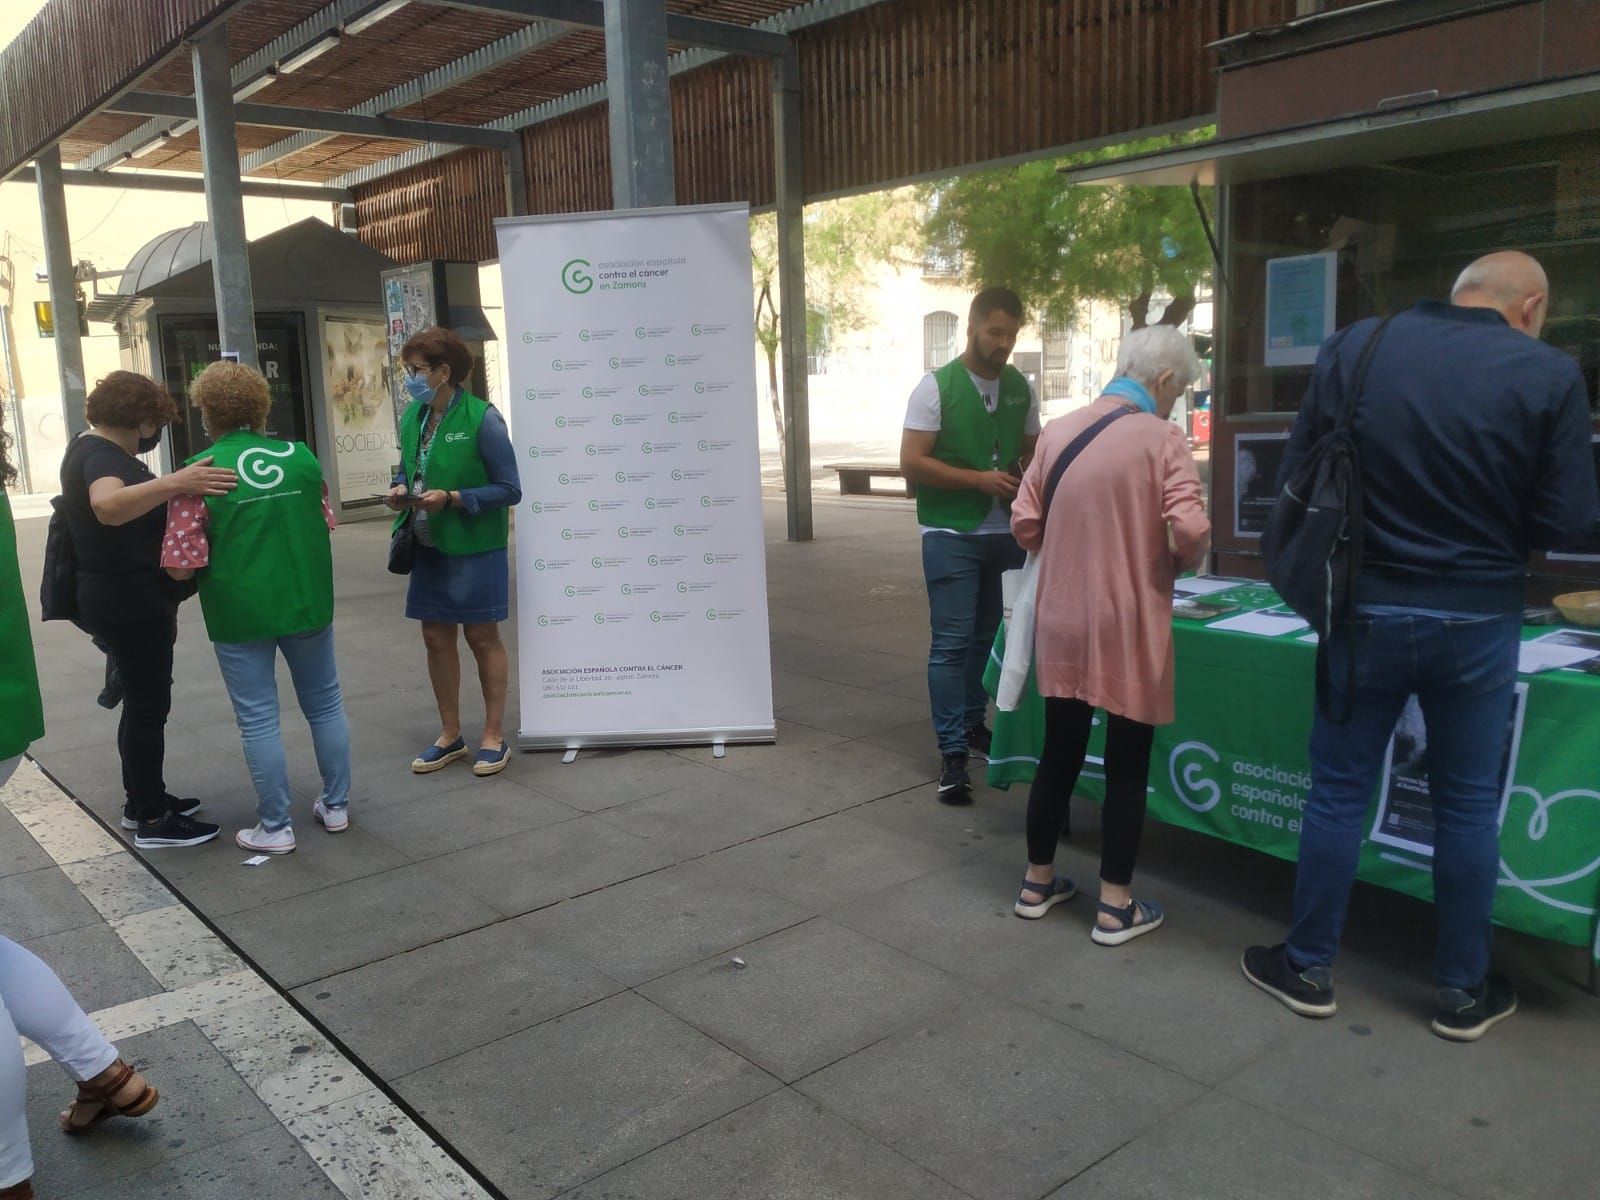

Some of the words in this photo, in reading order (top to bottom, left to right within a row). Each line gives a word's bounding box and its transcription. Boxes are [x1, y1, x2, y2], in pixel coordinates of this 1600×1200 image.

[598, 271, 628, 280] contra
[628, 269, 637, 279] el
[599, 283, 611, 291] en
[612, 280, 647, 290] Zamora
[583, 665, 618, 674] ESPAÑOLA
[618, 665, 647, 673] CONTRA
[1232, 761, 1313, 790] asociació
[1231, 804, 1284, 829] contra
